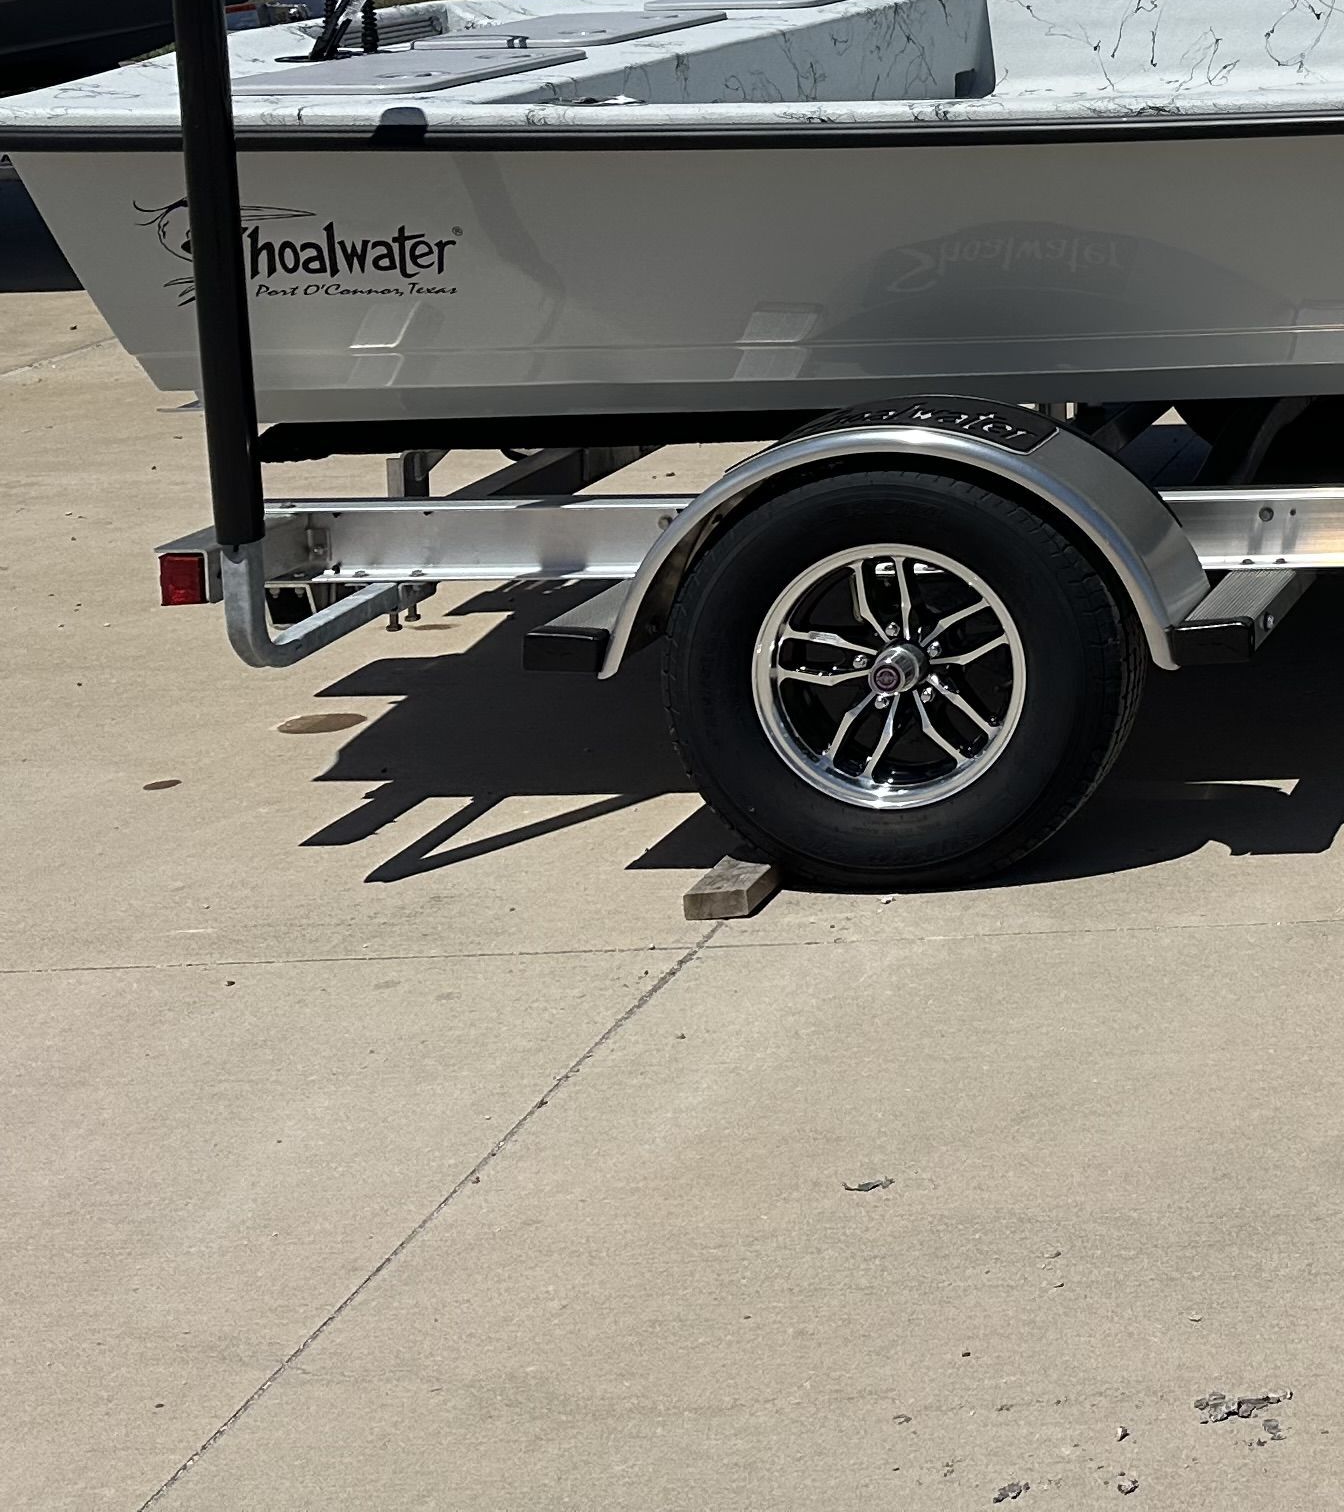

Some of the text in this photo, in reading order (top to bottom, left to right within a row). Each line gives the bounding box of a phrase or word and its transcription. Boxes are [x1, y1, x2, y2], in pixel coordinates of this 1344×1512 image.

[240, 221, 457, 280] hoalwater
[255, 283, 299, 297] Port
[408, 282, 459, 296] Texas
